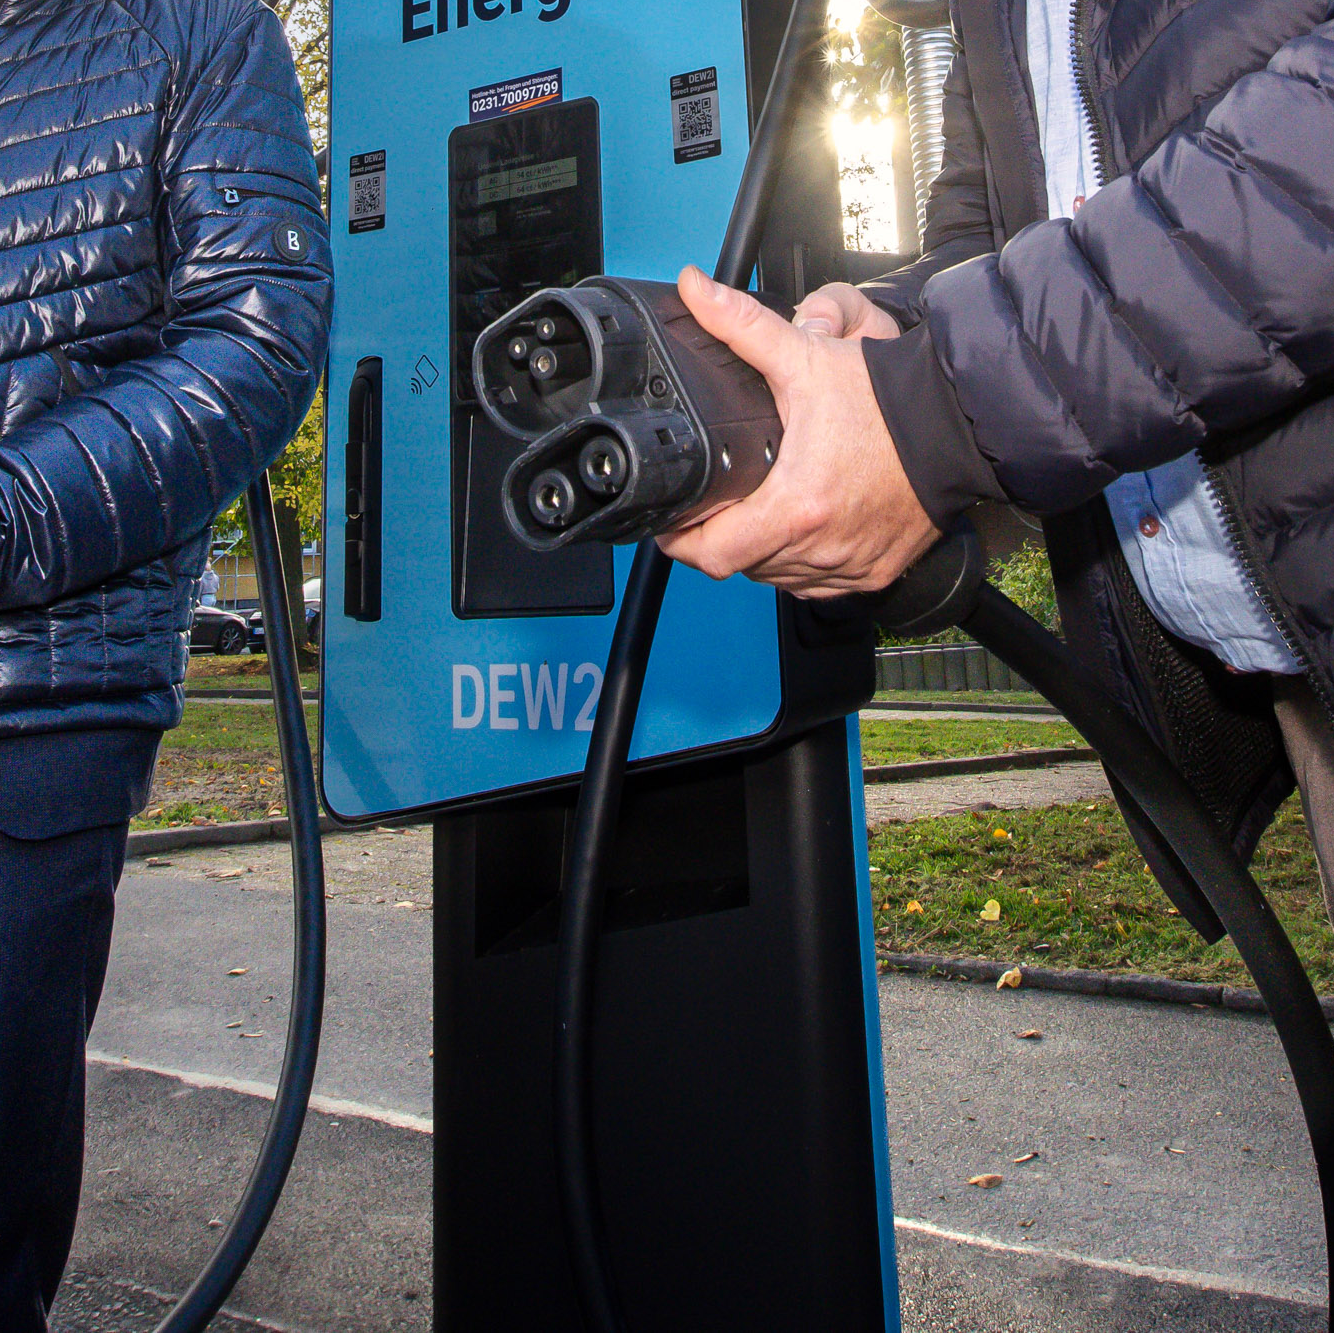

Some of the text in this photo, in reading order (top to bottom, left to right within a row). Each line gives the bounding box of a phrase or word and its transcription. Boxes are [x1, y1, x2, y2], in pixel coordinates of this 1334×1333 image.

[497, 86, 505, 94] bei
[505, 82, 522, 91] Fragen
[522, 79, 532, 87] und
[672, 87, 688, 96] direct
[690, 81, 716, 93] payment
[472, 81, 558, 113] 0231.70097799
[287, 230, 300, 251] B
